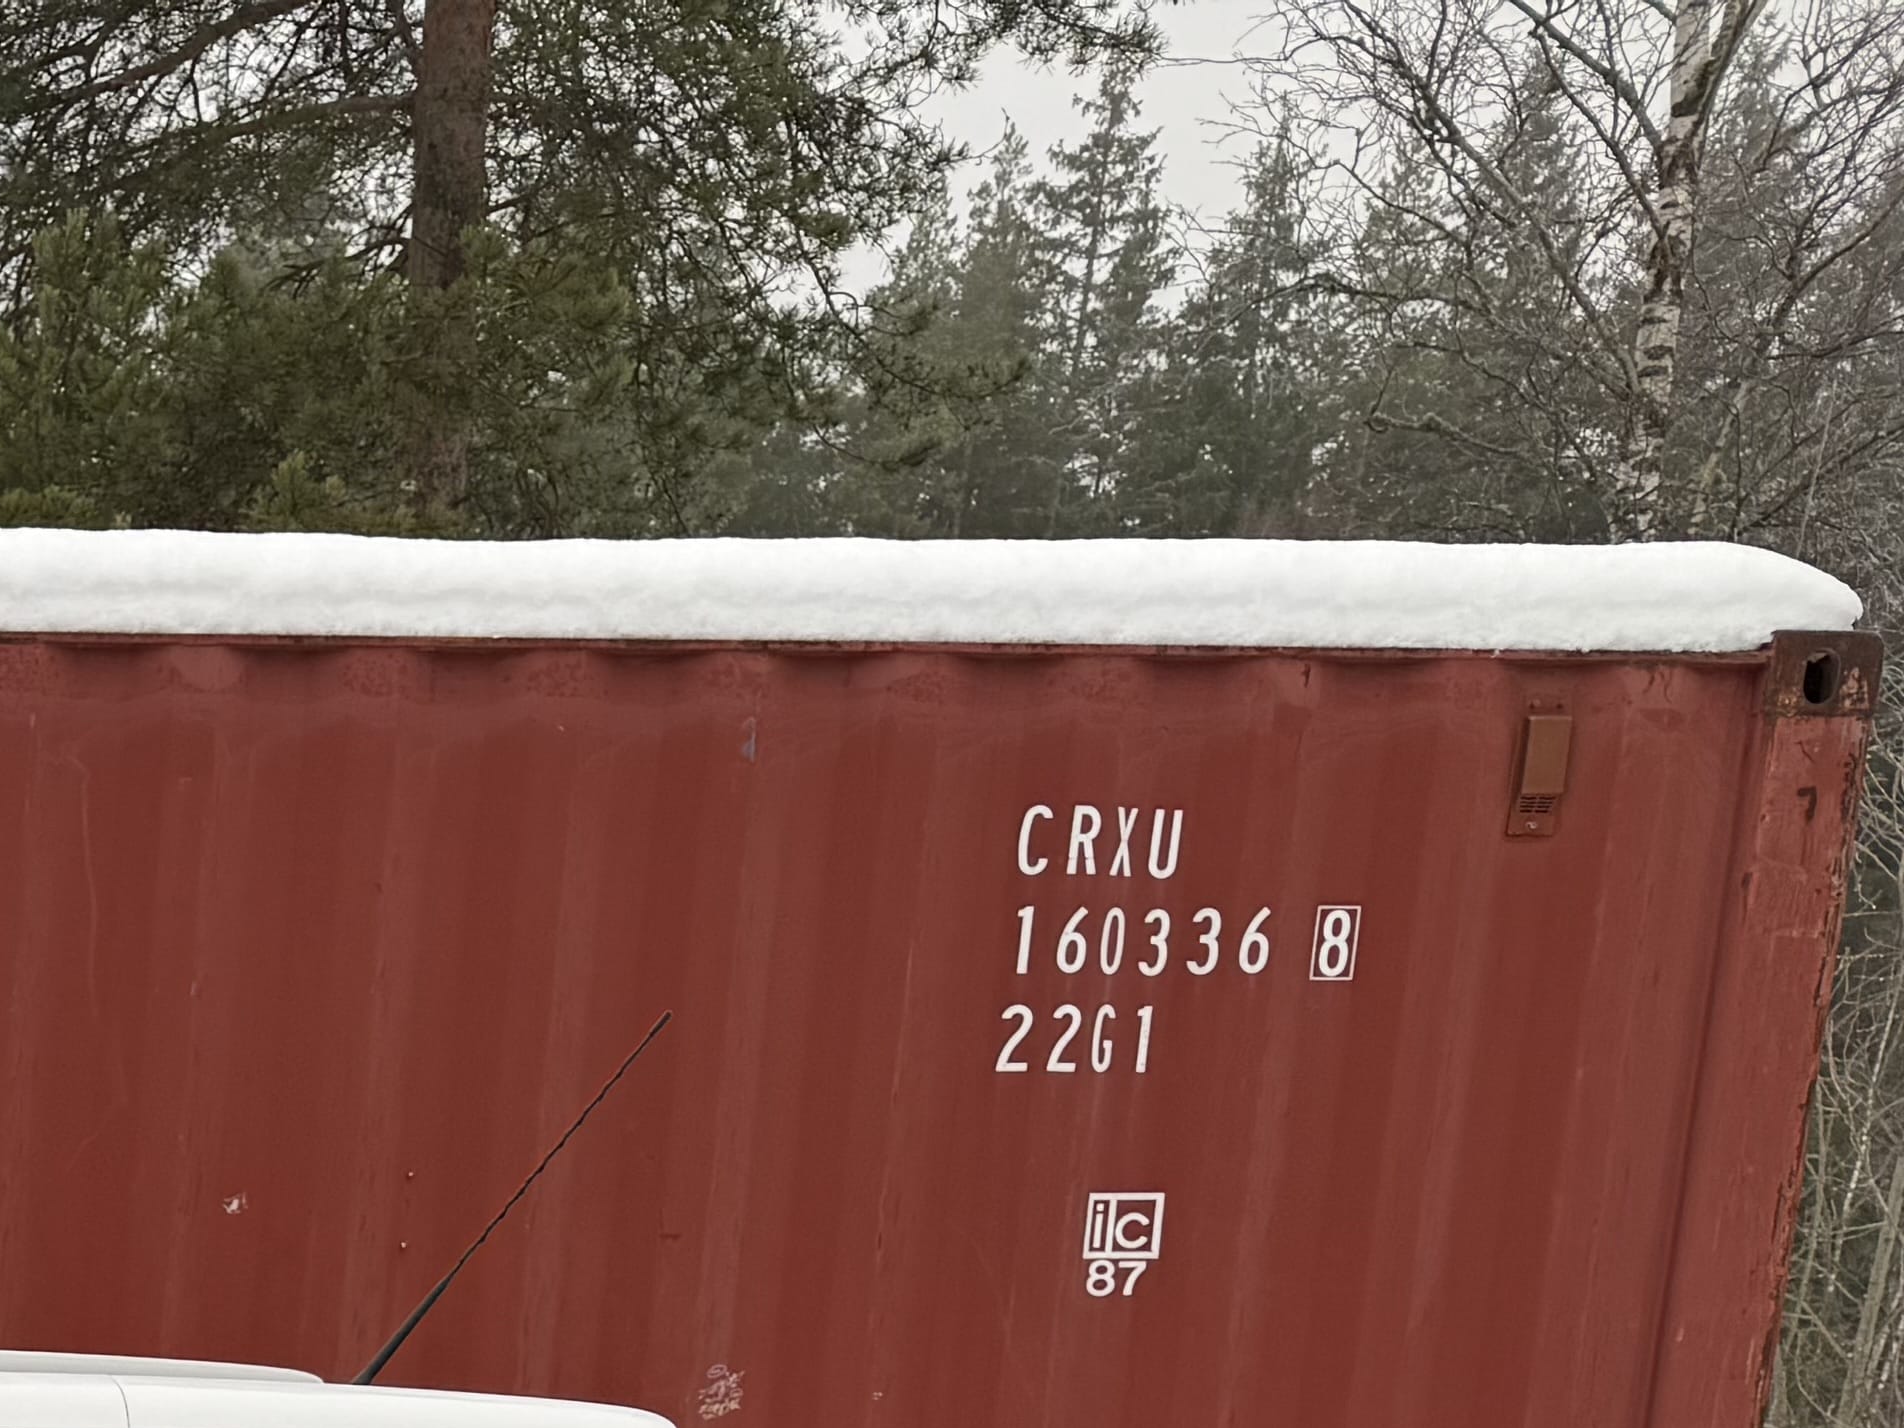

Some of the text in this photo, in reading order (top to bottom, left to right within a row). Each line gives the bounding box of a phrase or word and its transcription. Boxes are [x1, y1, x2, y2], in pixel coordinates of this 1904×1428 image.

[1017, 804, 1184, 880] CRXU
[1015, 905, 1353, 978] 160336 8
[995, 1004, 1154, 1074] 22G1
[1085, 1259, 1147, 1297] 87
